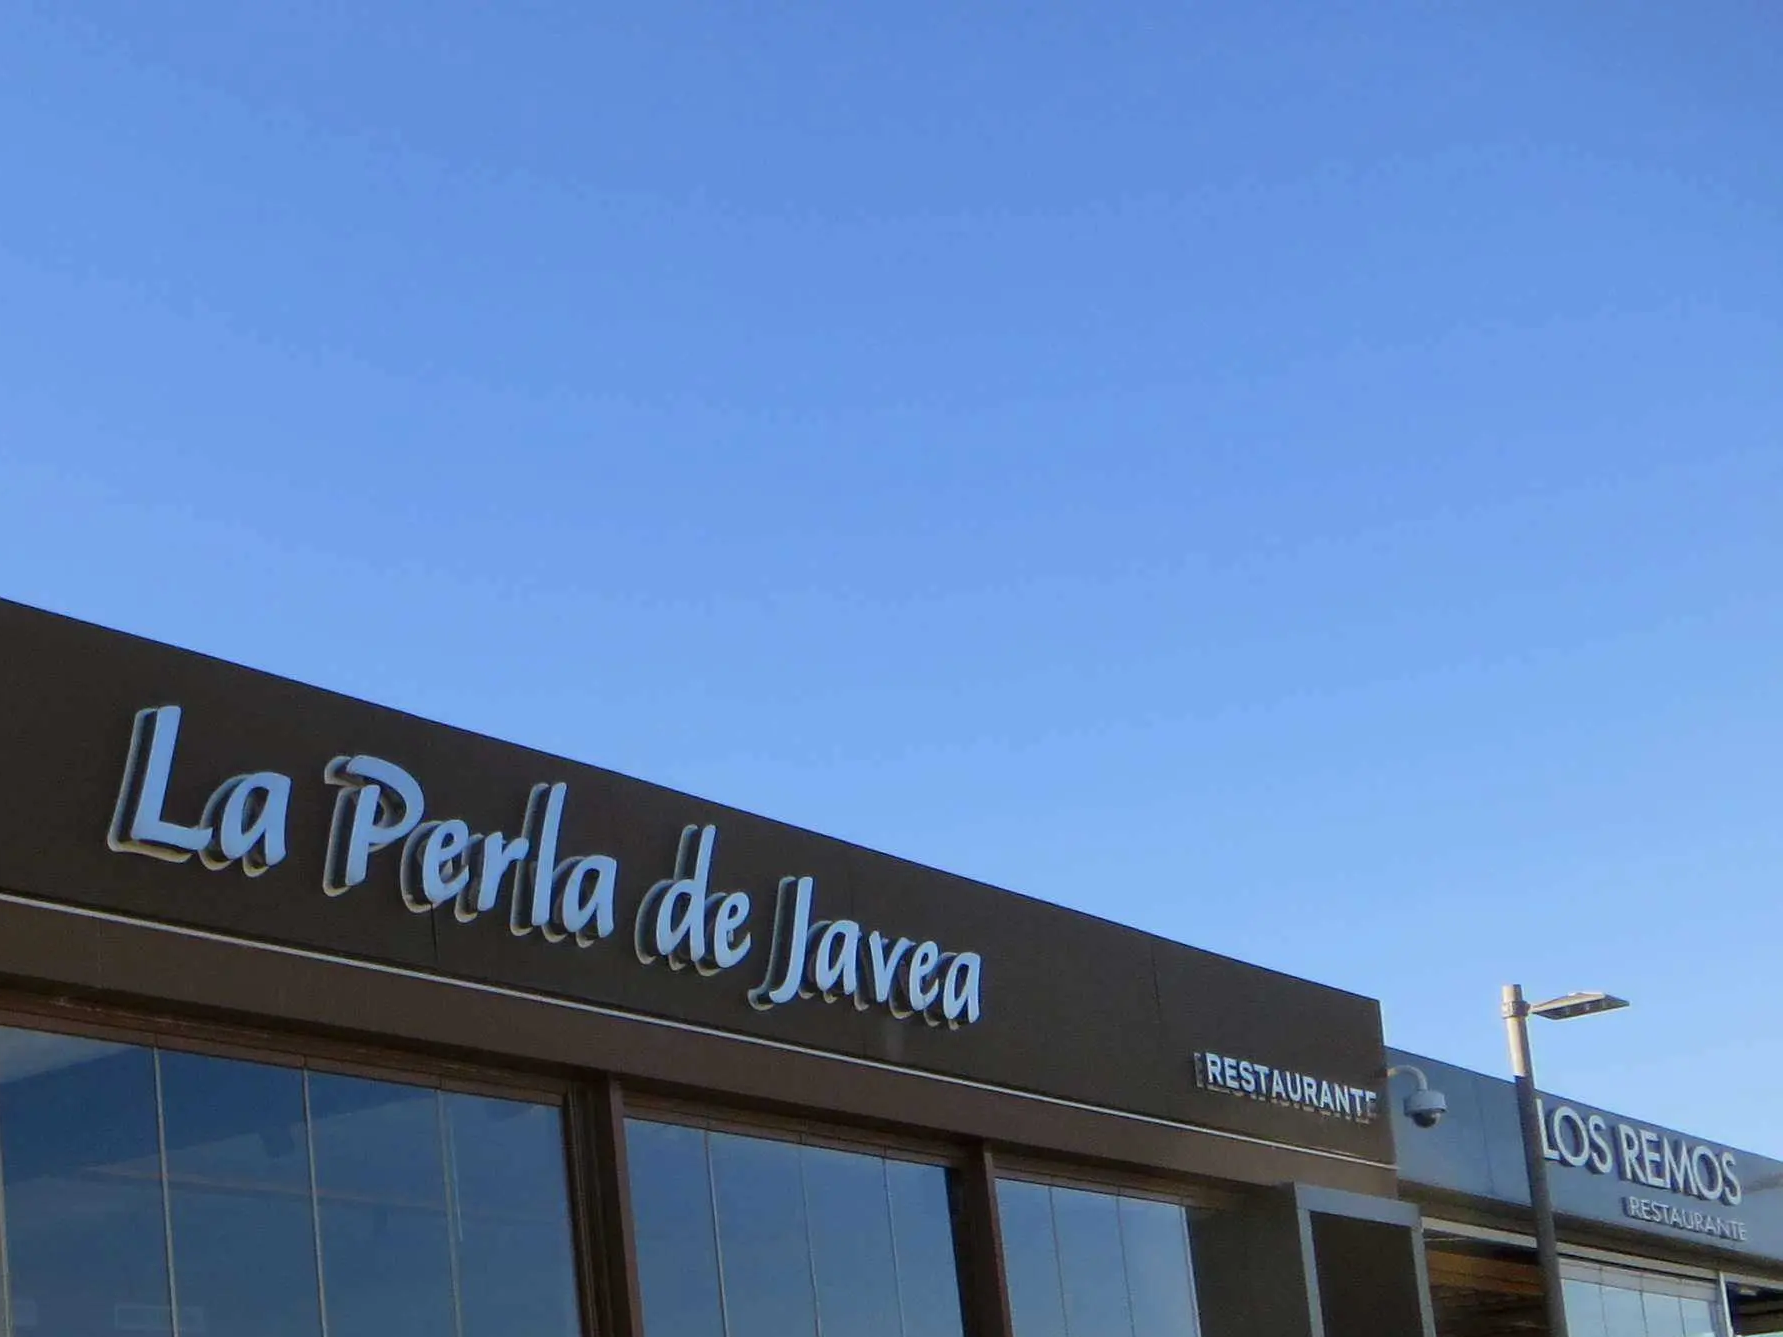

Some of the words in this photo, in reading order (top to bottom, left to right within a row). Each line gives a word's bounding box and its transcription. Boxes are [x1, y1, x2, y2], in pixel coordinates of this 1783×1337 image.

[122, 704, 293, 870] La
[333, 754, 617, 938] Perla
[649, 824, 752, 967] de
[762, 875, 983, 1022] Javea
[1203, 1052, 1378, 1118] RESTAURANTE
[1536, 1098, 1614, 1174] LOS
[1618, 1123, 1743, 1206] REMOS
[1627, 1195, 1749, 1242] RESTAURANTE
